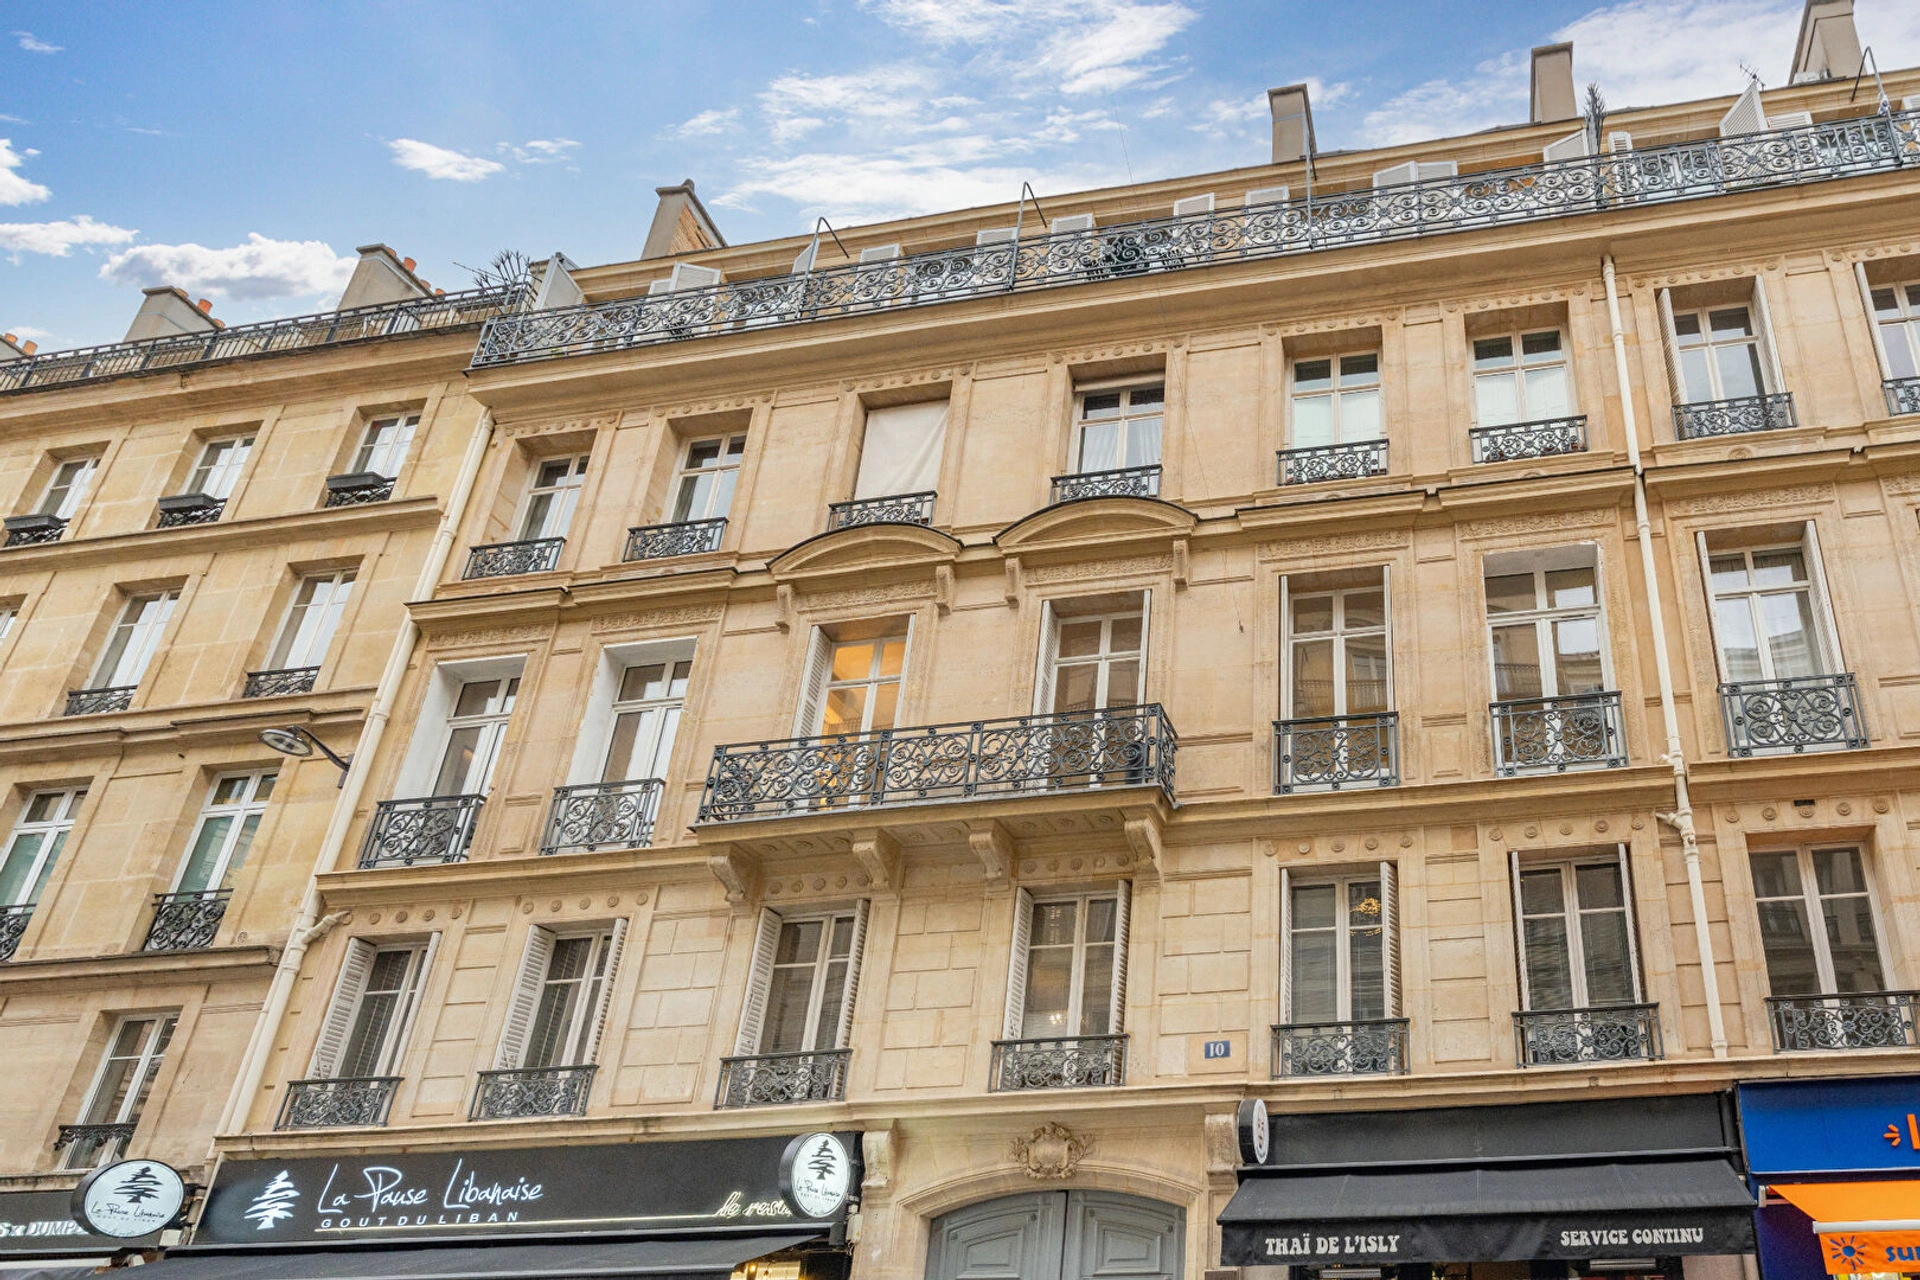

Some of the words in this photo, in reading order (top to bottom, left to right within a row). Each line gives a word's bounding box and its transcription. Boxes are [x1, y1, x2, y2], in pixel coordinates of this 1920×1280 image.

[1209, 1042, 1225, 1058] 10
[317, 1163, 351, 1213] La
[354, 1166, 428, 1213] Pause
[443, 1158, 544, 1208] Libanaise
[1264, 1233, 1311, 1255] THAÏ
[1315, 1236, 1339, 1254] DE
[1343, 1235, 1400, 1253] L'ISLY
[1560, 1229, 1629, 1246] SERVICE
[1631, 1228, 1703, 1245] CONTINU
